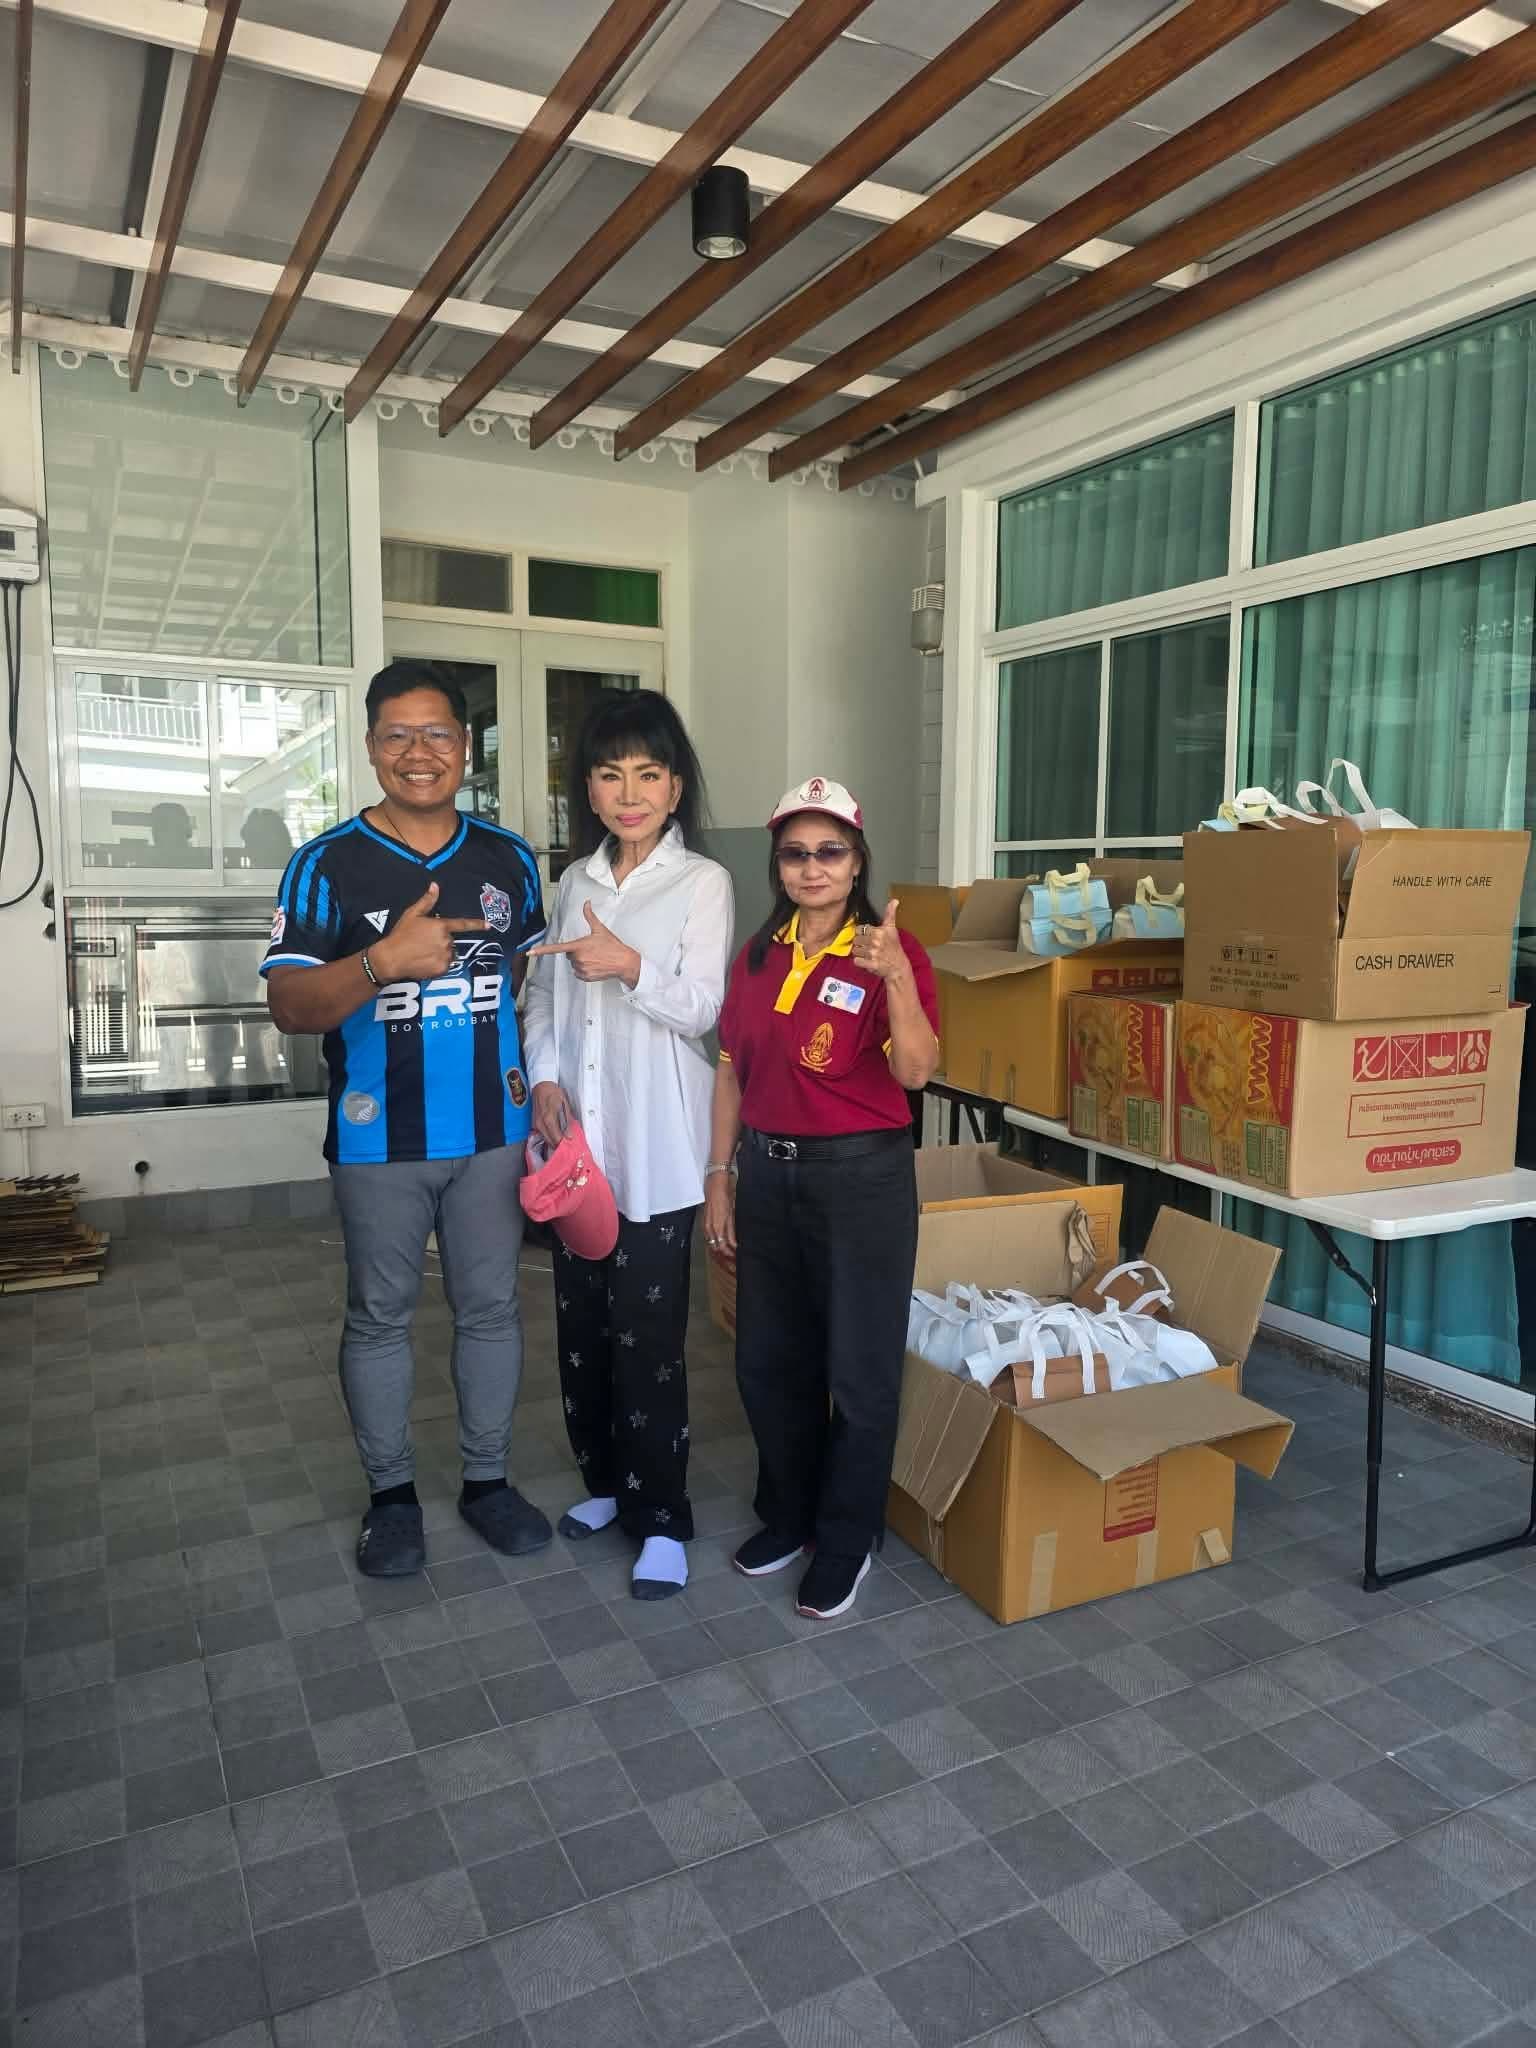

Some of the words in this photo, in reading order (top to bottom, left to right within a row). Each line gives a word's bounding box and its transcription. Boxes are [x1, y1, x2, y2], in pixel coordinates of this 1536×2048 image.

[1392, 876, 1433, 887] HANDLE
[1436, 876, 1462, 888] WITH
[1465, 876, 1493, 887] CARE
[1355, 955, 1392, 971] CASH
[1397, 953, 1455, 969] DRAWER
[1247, 1015, 1273, 1105] MAMA
